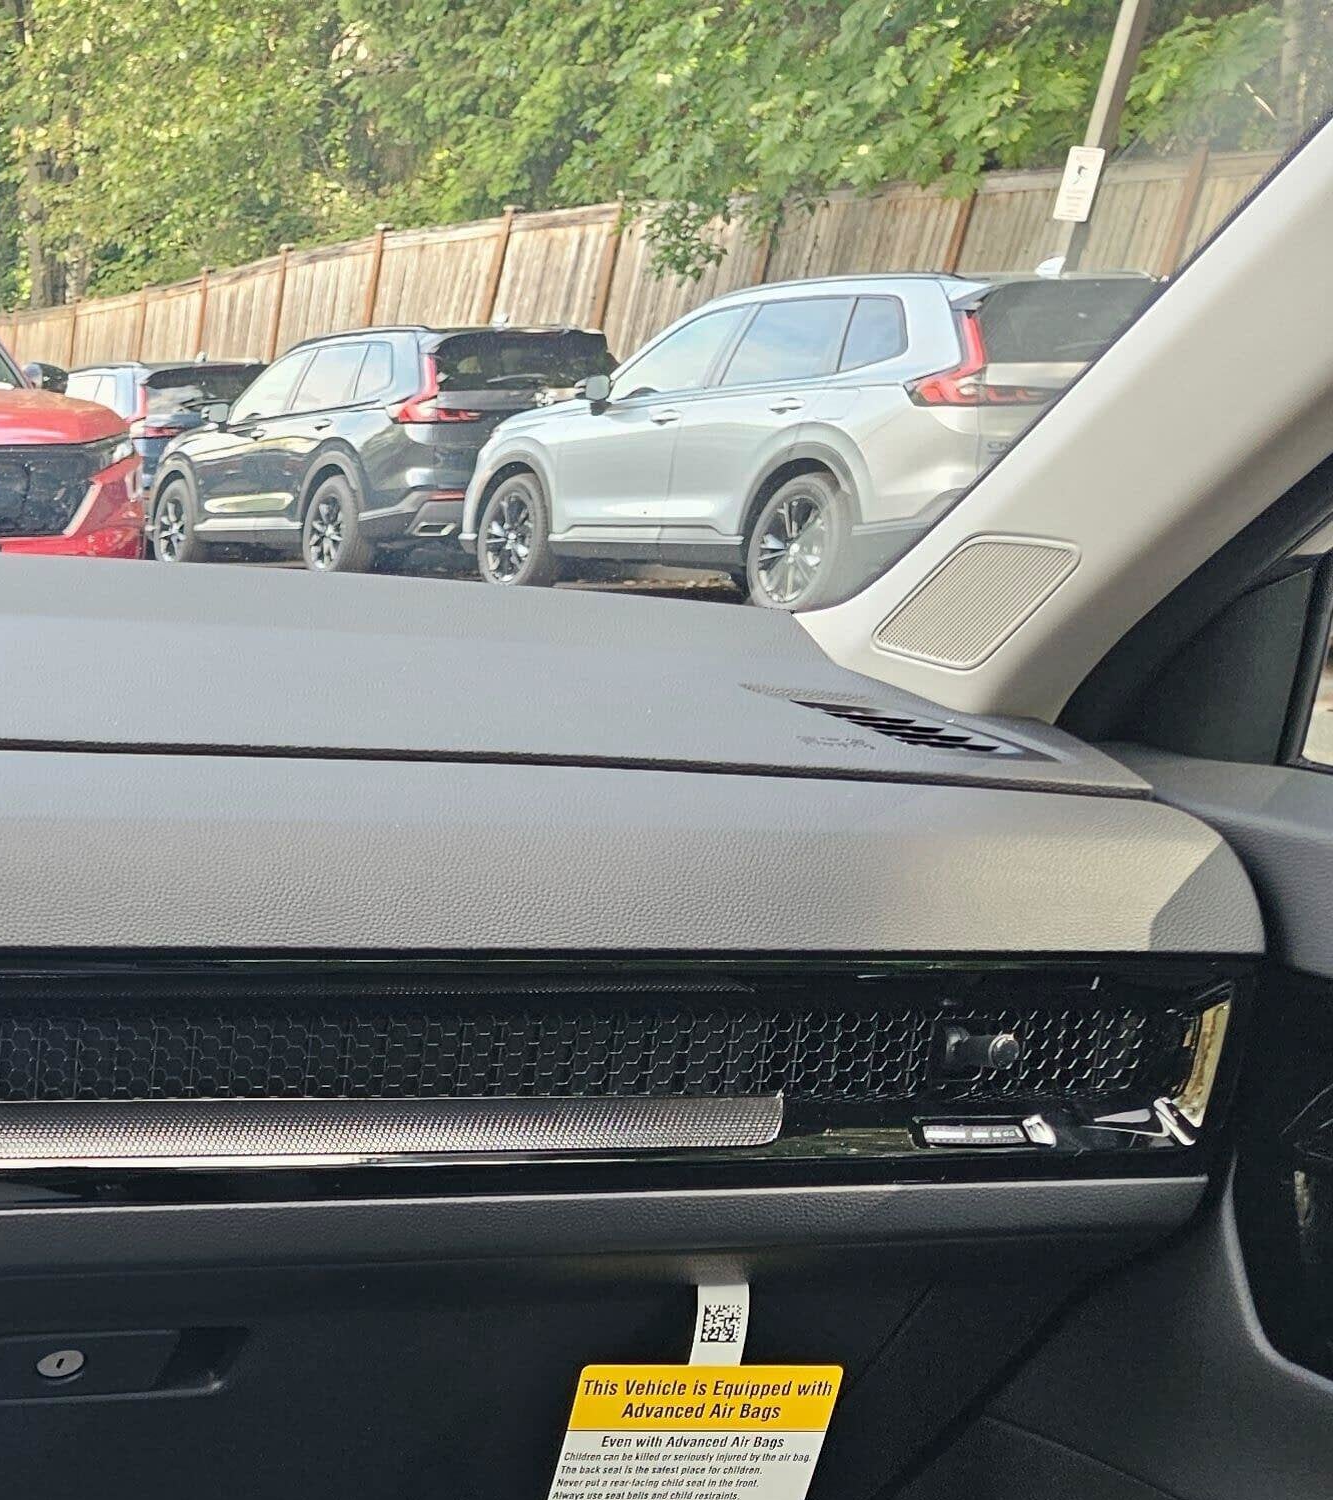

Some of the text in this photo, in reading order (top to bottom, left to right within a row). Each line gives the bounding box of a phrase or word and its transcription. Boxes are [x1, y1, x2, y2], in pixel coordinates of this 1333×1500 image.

[584, 1379, 833, 1400] This Vehicle is Equipped with
[621, 1402, 781, 1422] Advanced Air Bags
[601, 1435, 785, 1450] Even with Advanced Air Bags
[564, 1452, 601, 1461] Children
[621, 1453, 633, 1461] be
[635, 1453, 660, 1461] killed
[673, 1453, 714, 1463] seriously
[715, 1453, 747, 1463] injured
[749, 1453, 762, 1463] by
[762, 1453, 778, 1462] the
[778, 1453, 791, 1461] air
[561, 1465, 763, 1475] The back seat is the safest place for children.
[556, 1478, 583, 1487] Never
[585, 1479, 600, 1488] put
[610, 1479, 660, 1488] rear-facing
[661, 1479, 684, 1488] child
[686, 1479, 706, 1488] seat
[707, 1479, 717, 1487] in
[718, 1479, 733, 1487] the
[734, 1479, 759, 1488] front.
[553, 1491, 584, 1500] Always
[604, 1492, 625, 1500] seat
[627, 1492, 649, 1500] belts
[651, 1492, 669, 1500] and
[670, 1492, 693, 1500] child
[694, 1492, 740, 1500] restraints.
